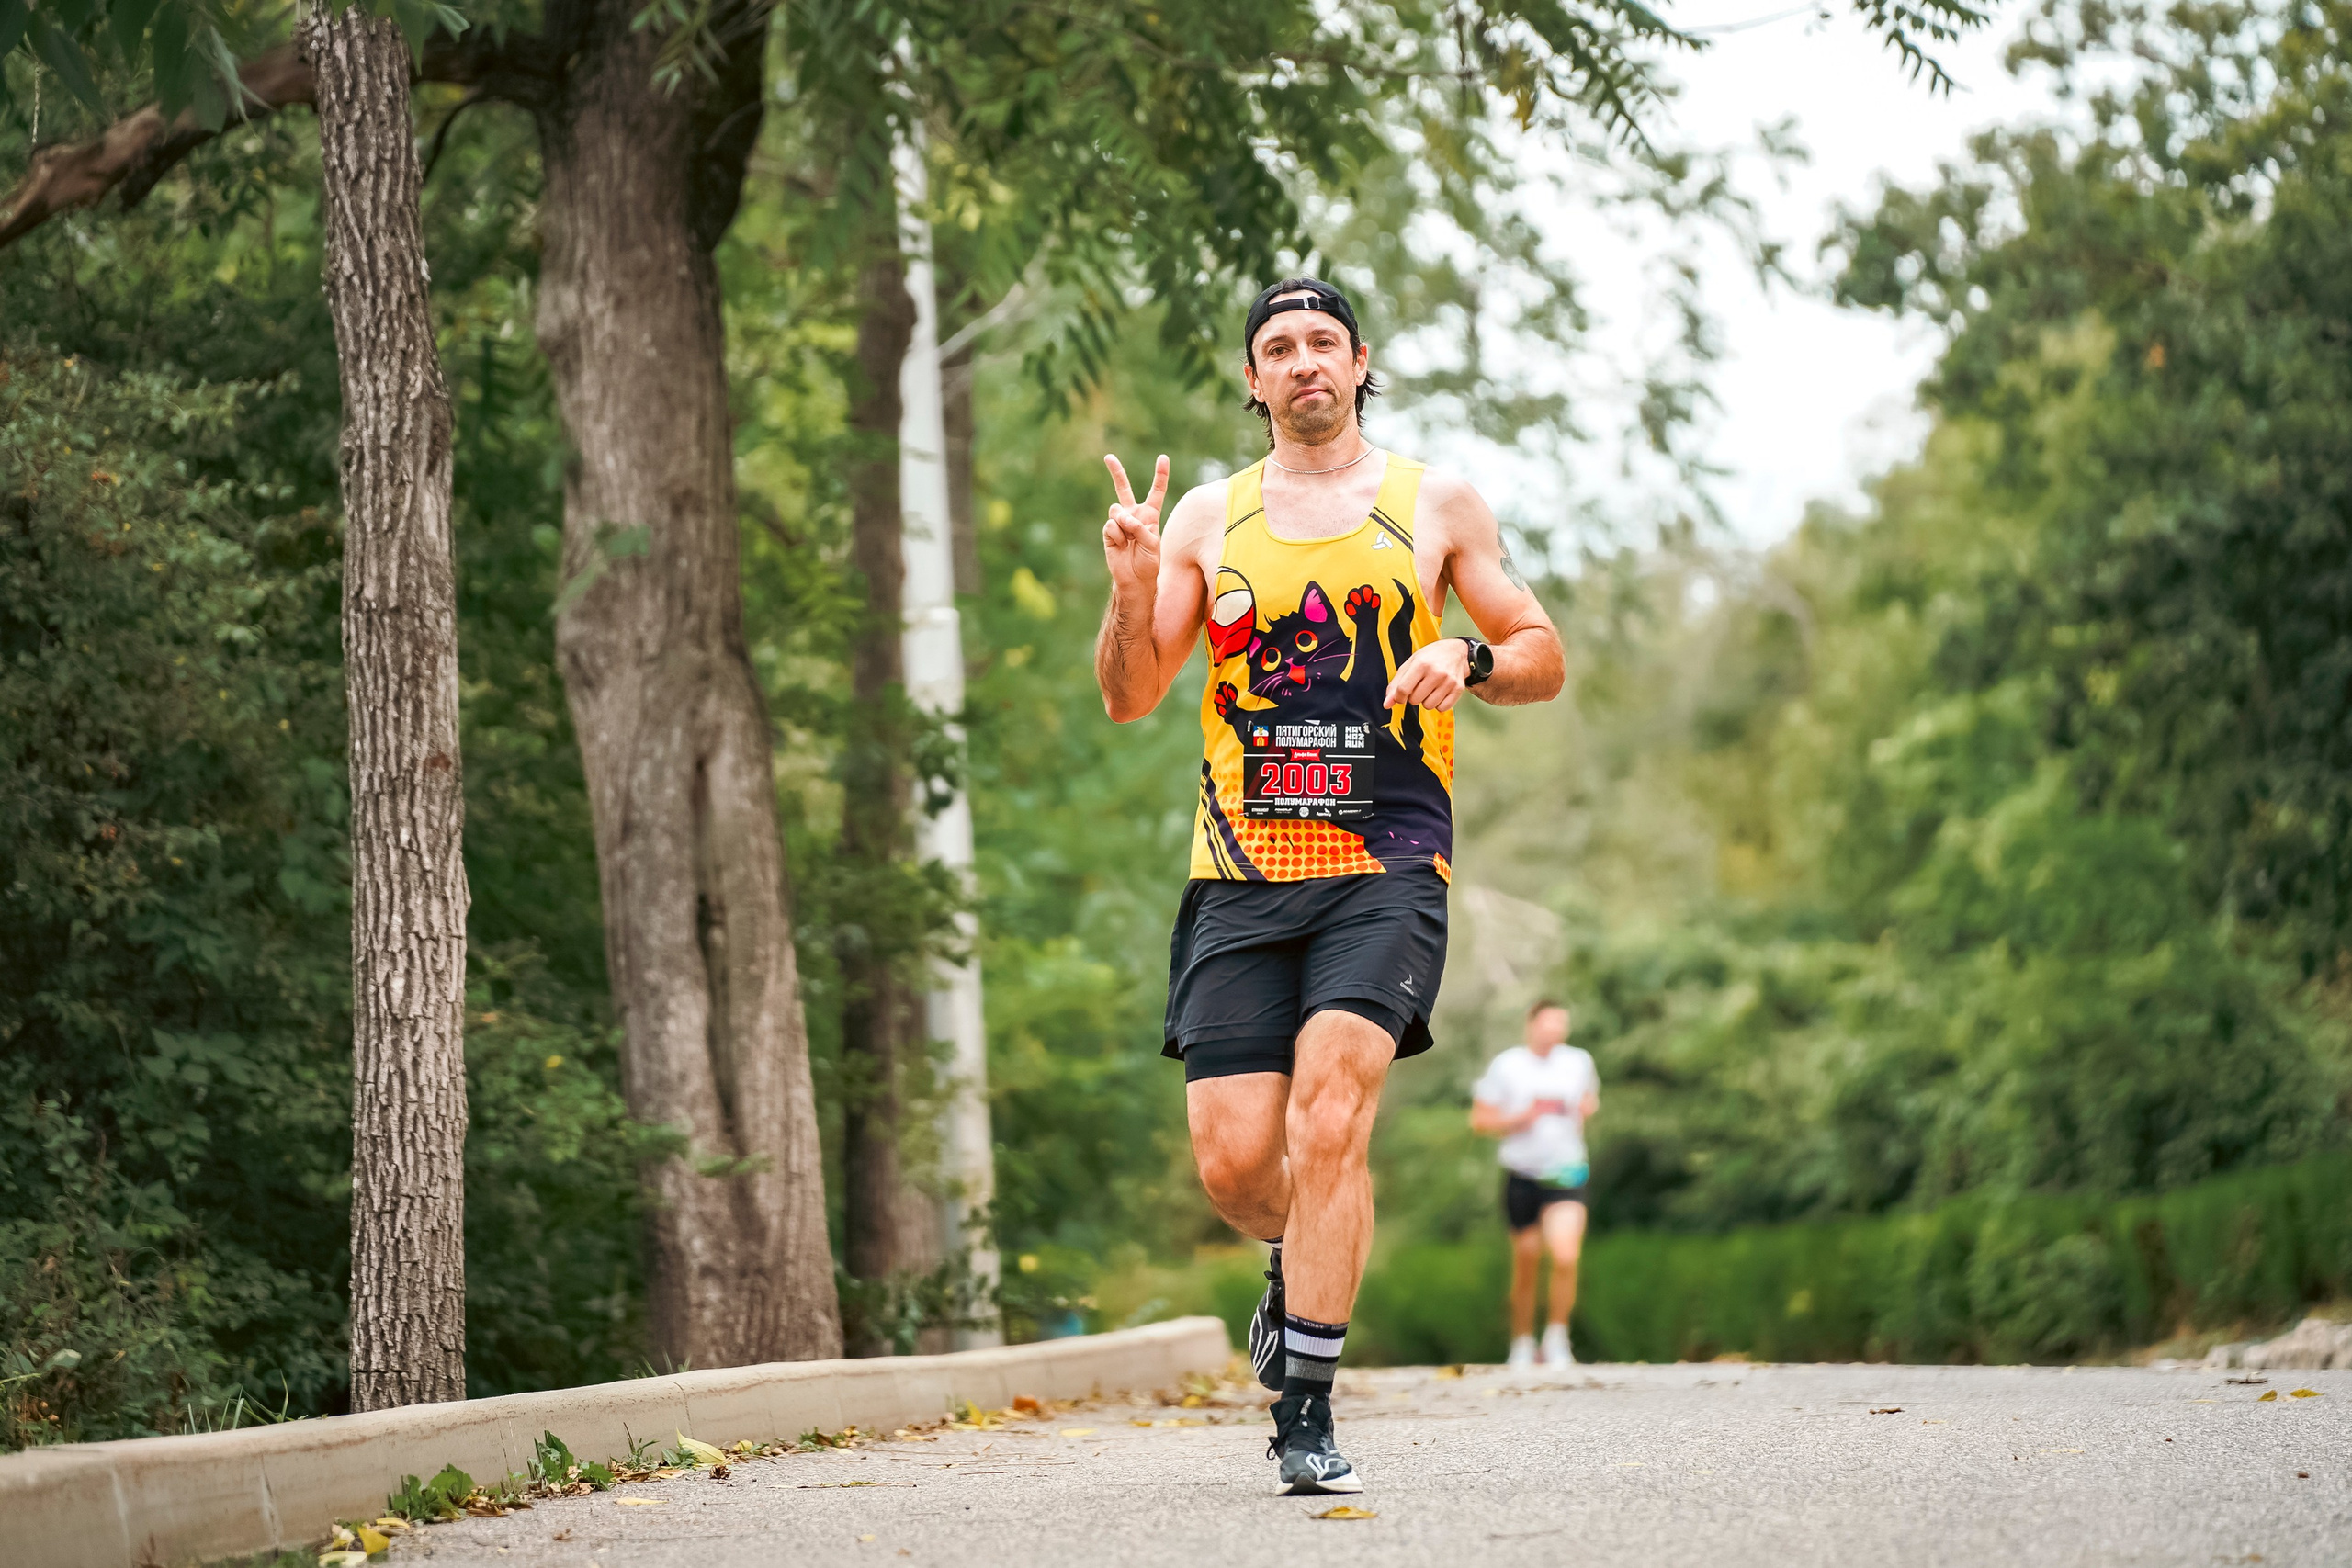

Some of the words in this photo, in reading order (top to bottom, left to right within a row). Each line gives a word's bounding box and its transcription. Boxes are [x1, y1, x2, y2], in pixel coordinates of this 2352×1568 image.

[1275, 724, 1337, 737] ПЯТИГОРСКИЙ
[1275, 737, 1337, 748] ПОЛУМАРАФОН
[1261, 763, 1351, 795] 2003
[1274, 797, 1336, 807] ПОЛУМАРАФОН
